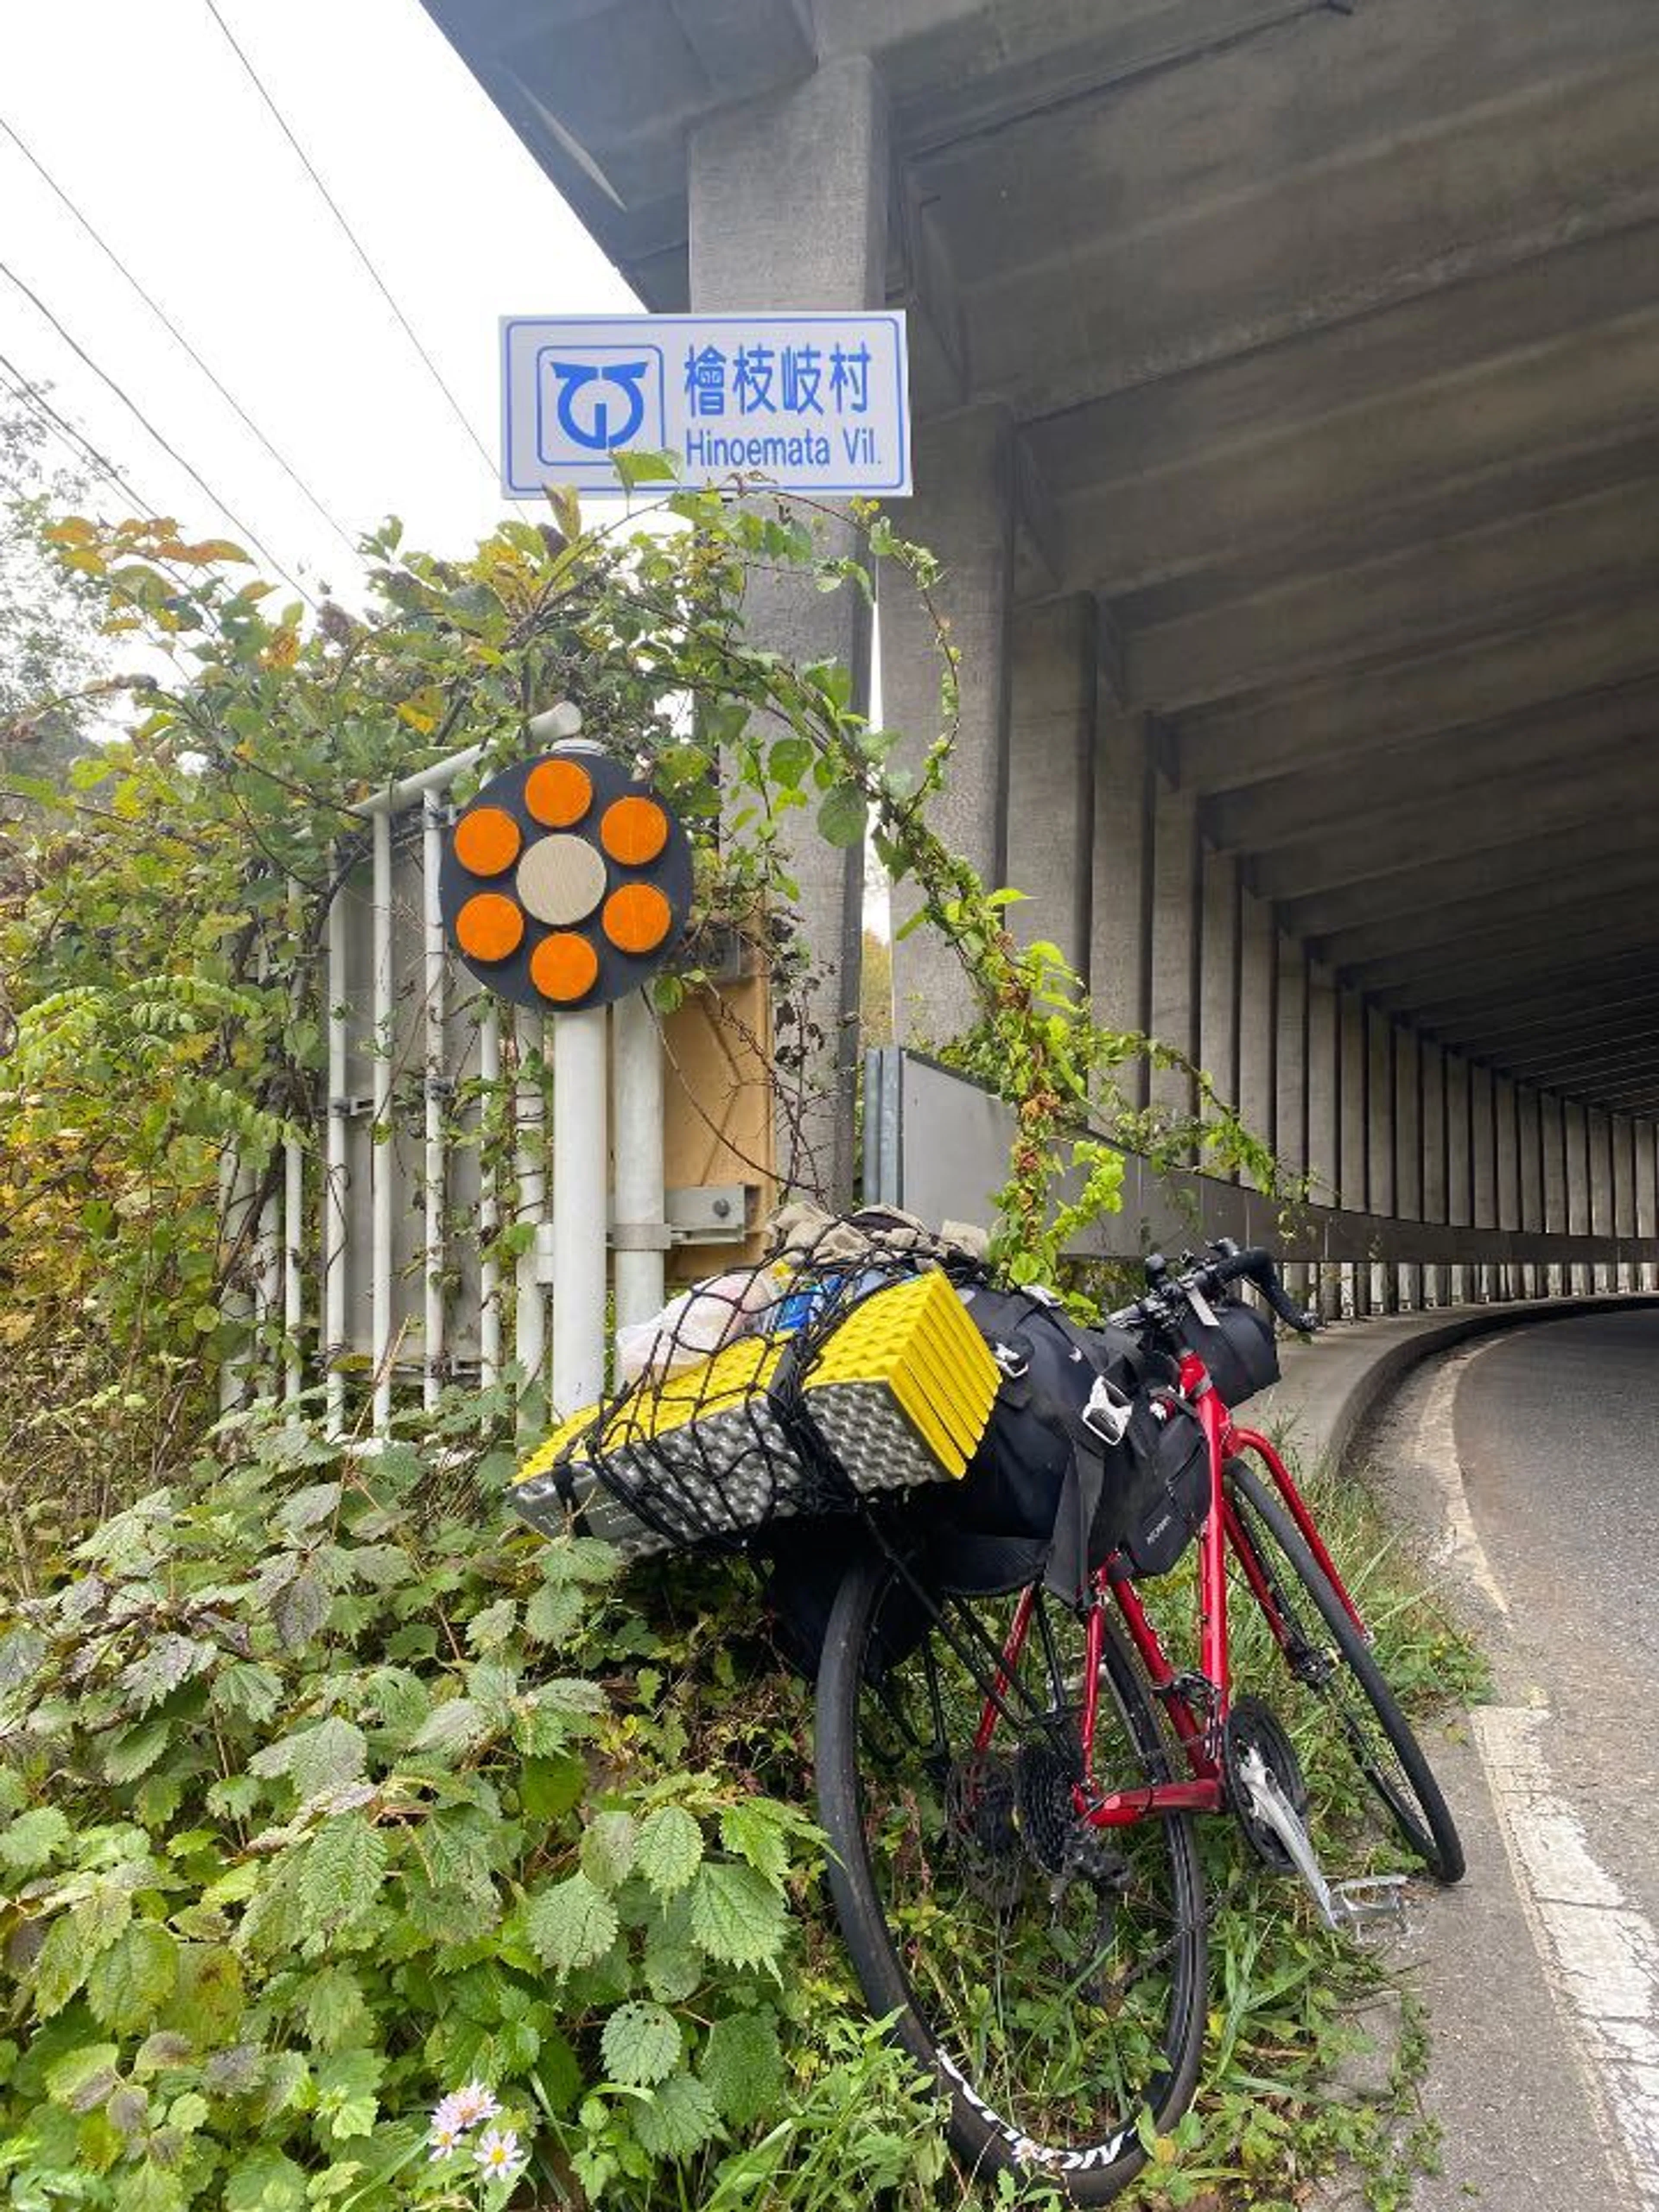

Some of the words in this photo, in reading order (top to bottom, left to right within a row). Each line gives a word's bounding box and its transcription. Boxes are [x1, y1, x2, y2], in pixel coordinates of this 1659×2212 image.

[684, 340, 871, 417] 檜枝岐村
[686, 429, 830, 467] Hinoemata
[843, 428, 881, 465] Vil.
